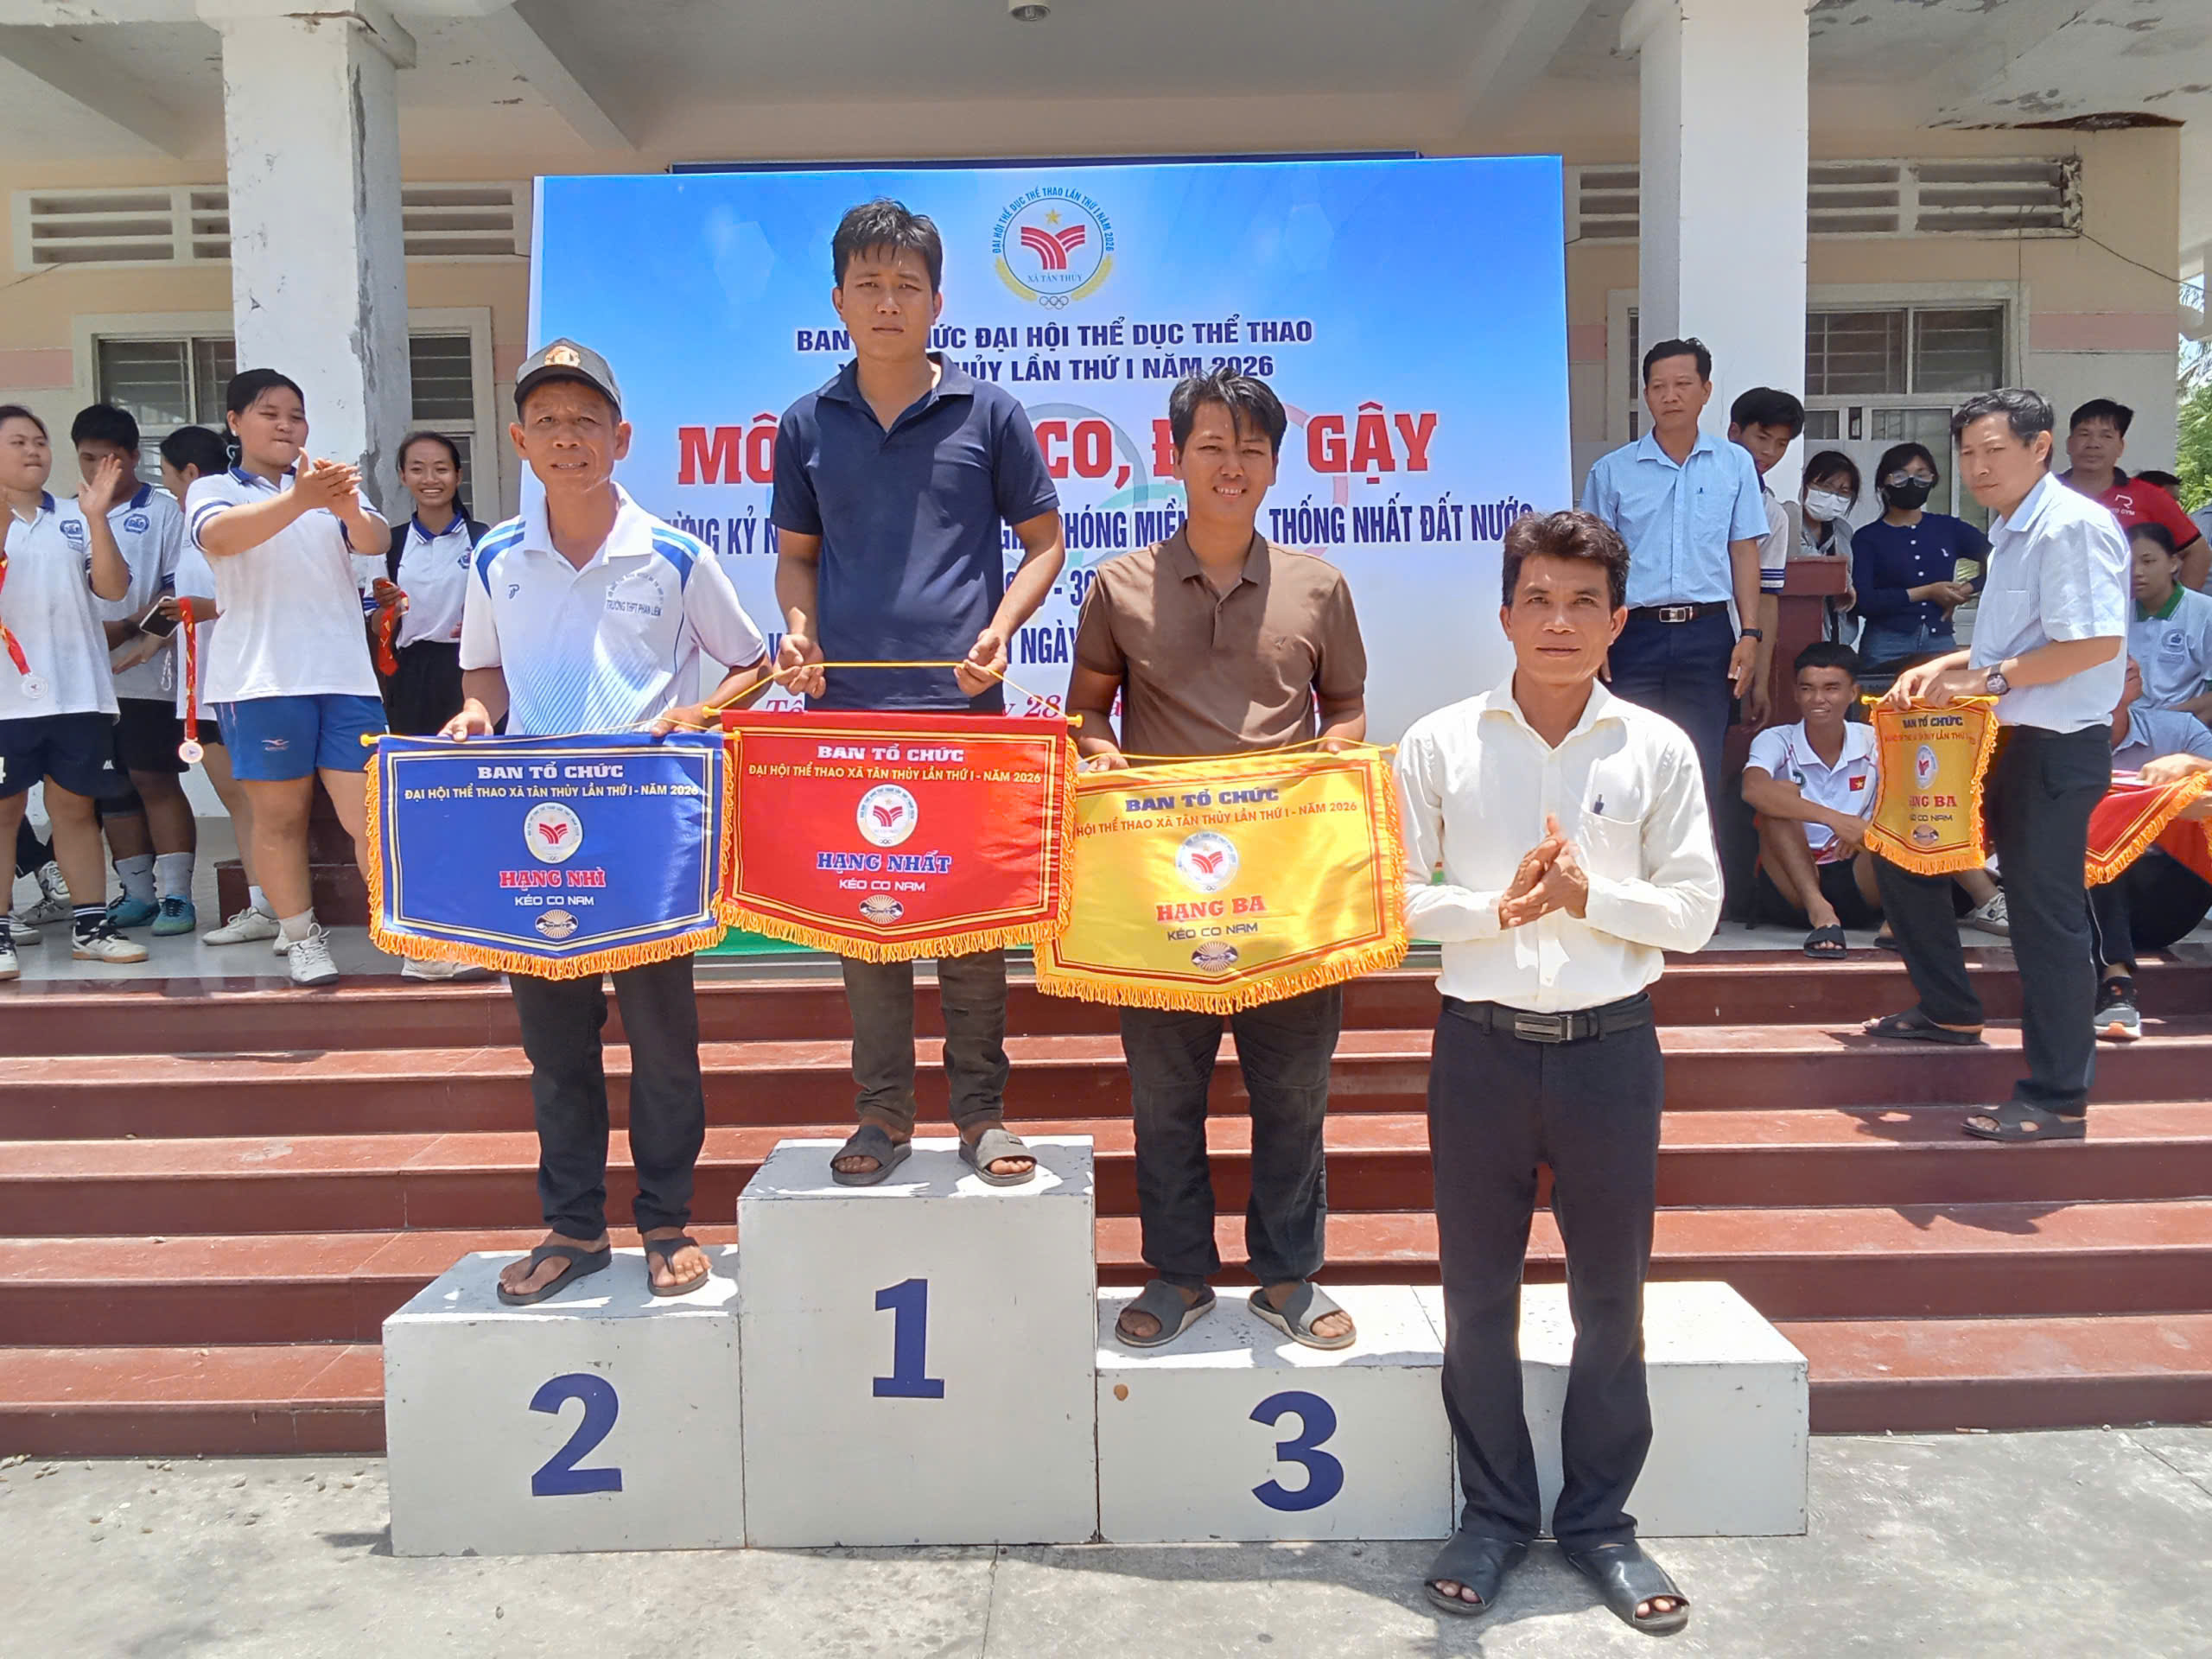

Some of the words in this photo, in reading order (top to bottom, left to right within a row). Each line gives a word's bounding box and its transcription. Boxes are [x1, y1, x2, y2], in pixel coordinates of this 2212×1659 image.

[1042, 187, 1063, 197] THAO
[1104, 232, 1115, 251] 2026
[798, 330, 849, 351] BAN
[976, 327, 1017, 353] ĐẠI
[1027, 321, 1069, 352] HỘI
[1077, 316, 1125, 346] THỂ
[1133, 323, 1184, 349] DỤC
[1192, 314, 1239, 344] THỂ
[1247, 321, 1312, 343] THAO
[1012, 353, 1060, 381] LẦN
[1070, 354, 1119, 380] THỨ
[1126, 359, 1133, 378] I
[1143, 353, 1202, 378] NĂM
[1212, 356, 1274, 377] 2026
[678, 413, 778, 485] MÔ
[1306, 401, 1438, 484] GẬY
[728, 505, 757, 554] KỶ
[1061, 505, 1127, 549] HÓNG
[1269, 494, 1345, 544] THỐNG
[1353, 493, 1413, 543] NHẤT
[1420, 492, 1463, 542] ĐẤT
[1025, 695, 1061, 717] 28
[817, 746, 865, 760] BAN
[872, 743, 900, 761] TỔ
[907, 747, 964, 762] CHỨC
[478, 766, 523, 779] BAN
[529, 761, 558, 779] TỔ
[564, 763, 624, 779] CHỨC
[748, 765, 767, 778] ĐẠI
[770, 763, 790, 779] HỘI
[792, 761, 813, 777] THỂ
[815, 766, 845, 778] THAO
[848, 766, 864, 778] XÃ
[867, 766, 888, 779] TÂN
[892, 766, 919, 780] THỦY
[923, 766, 944, 780] LẦN
[946, 767, 968, 781] THỨ
[983, 769, 1010, 782] NĂM
[1014, 772, 1041, 783] 2026
[404, 789, 425, 802] ĐẠI
[428, 786, 450, 801] HỘI
[453, 783, 474, 798] THỂ
[476, 787, 506, 798] THAO
[509, 785, 524, 798] XÃ
[527, 785, 548, 798] TÂN
[550, 784, 579, 798] THỦY
[582, 782, 604, 797] LẦN
[607, 783, 627, 796] THỨ
[641, 783, 667, 795] NĂM
[670, 785, 699, 796] 2026
[1125, 796, 1175, 811] BAN
[1181, 789, 1211, 807] TỔ
[1218, 787, 1279, 804] CHỨC
[1934, 795, 1957, 808] BA
[1077, 823, 1096, 839] HỘI
[1099, 817, 1119, 834] THỂ
[1121, 819, 1153, 830] THAO
[1156, 816, 1173, 828] XÃ
[1176, 814, 1198, 826] TÂN
[1202, 810, 1231, 824] THỦY
[1235, 807, 1256, 823] LẦN
[1260, 807, 1282, 820] THỨ
[1299, 802, 1326, 815] NĂM
[1330, 802, 1357, 812] 2026
[817, 852, 881, 874] HẠNG
[887, 850, 951, 874] NHẤT
[499, 870, 563, 891] HẠNG
[566, 867, 606, 887] NHÌ
[839, 877, 867, 889] KÉO
[871, 880, 891, 890] CO
[894, 881, 925, 892] NAM
[515, 894, 543, 906] KÉO
[546, 896, 564, 906] CO
[568, 896, 594, 906] NAM
[1156, 900, 1224, 922] HẠNG
[1231, 895, 1267, 913] BA
[1167, 927, 1196, 941] KÉO
[1201, 927, 1221, 936] CO
[1226, 923, 1258, 934] NAM
[873, 1278, 944, 1399] 1
[529, 1373, 623, 1497] 2
[1249, 1390, 1344, 1512] 3
